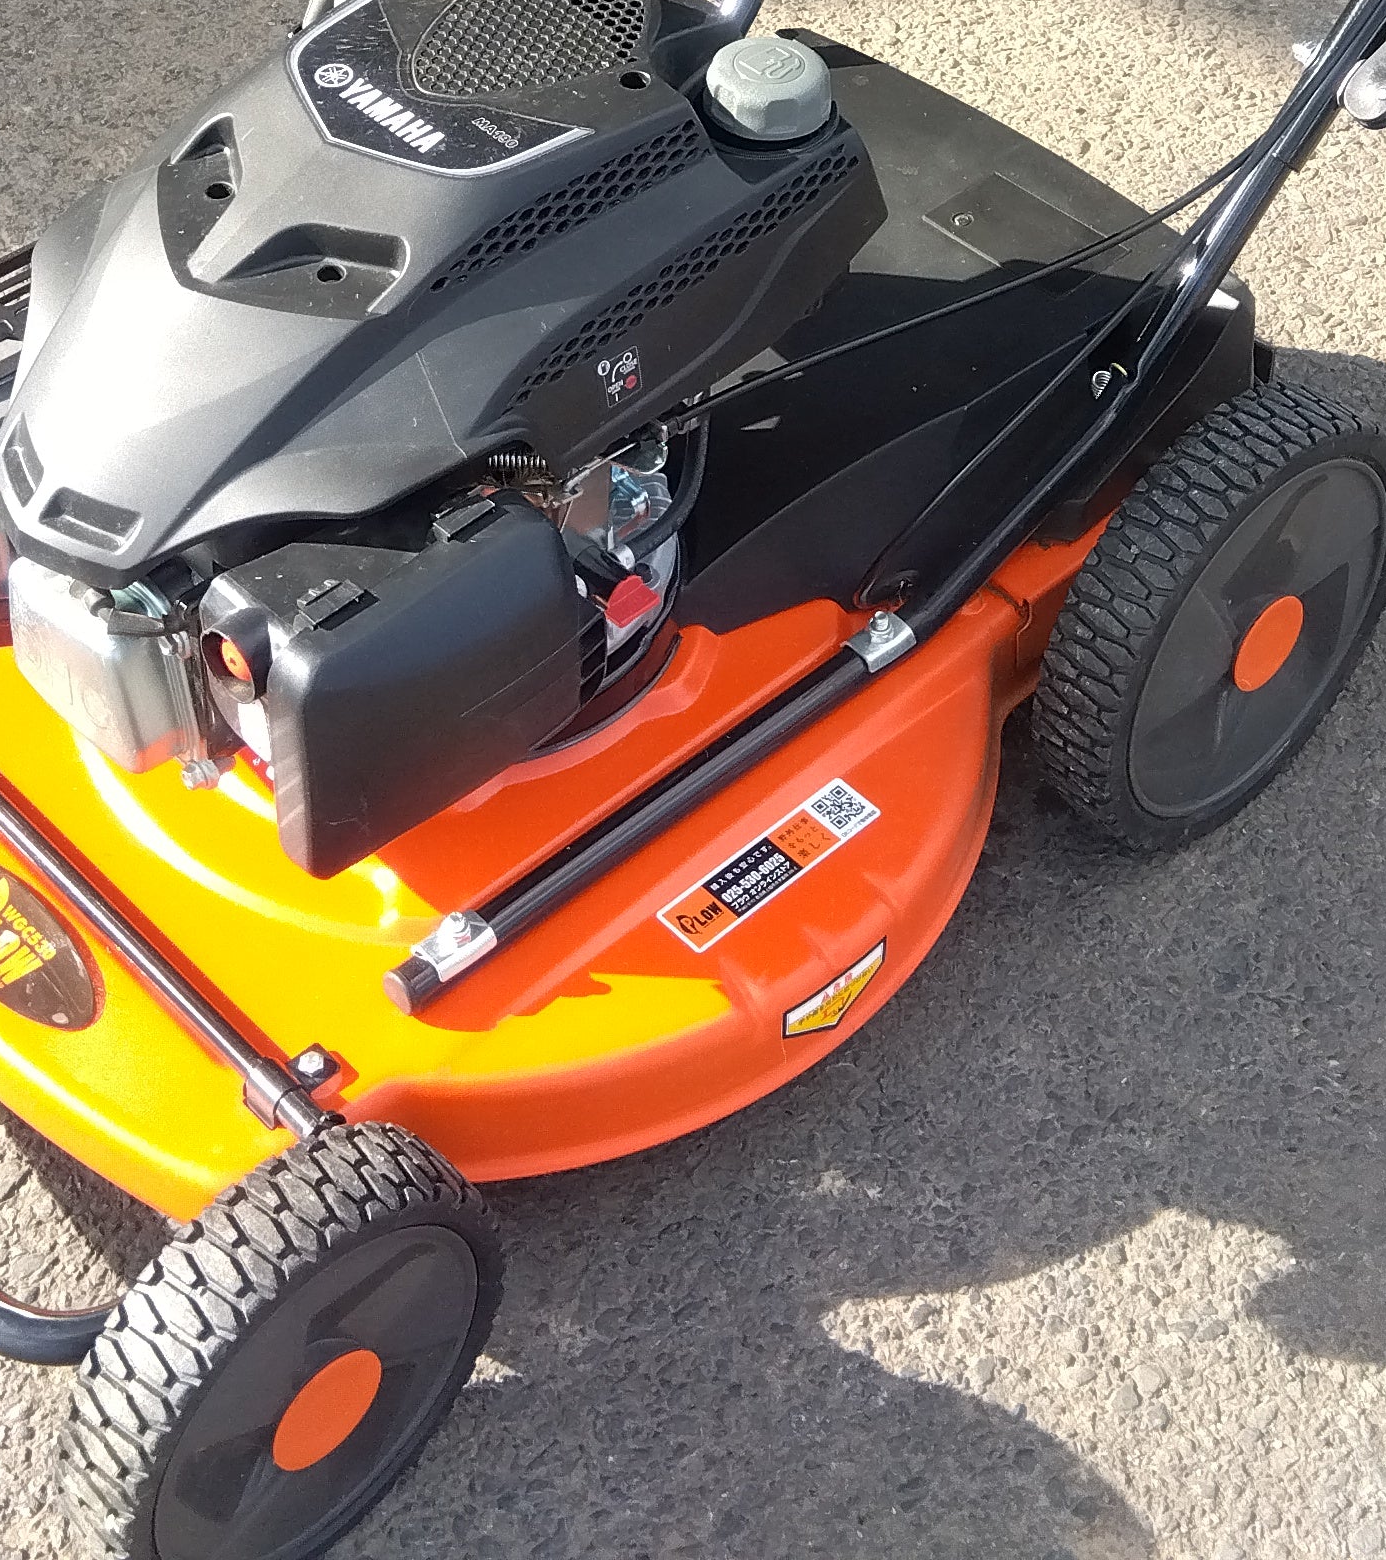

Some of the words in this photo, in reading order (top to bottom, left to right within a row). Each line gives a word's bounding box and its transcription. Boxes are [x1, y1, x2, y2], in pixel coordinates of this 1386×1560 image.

[339, 77, 446, 154] YAMAHA
[472, 117, 519, 148] MA190
[797, 834, 832, 859] 楽しく
[721, 852, 786, 903] 025-530-6025
[3, 904, 56, 960] WGC530
[676, 901, 724, 935] PLOW
